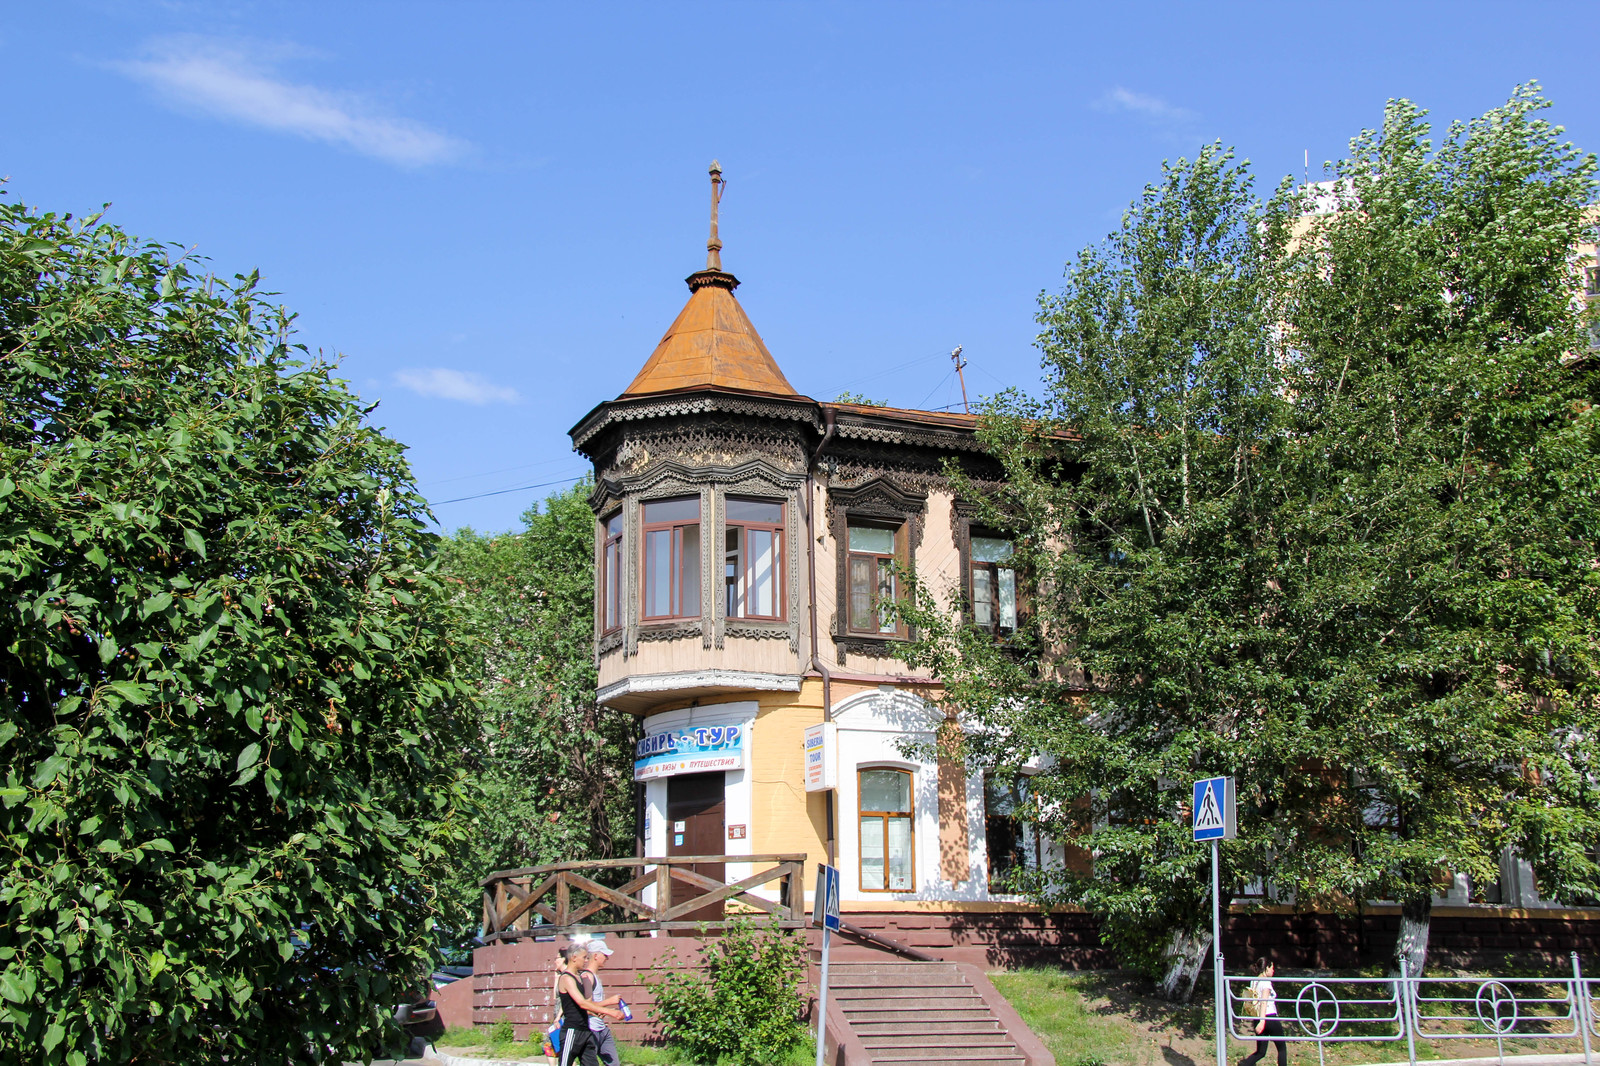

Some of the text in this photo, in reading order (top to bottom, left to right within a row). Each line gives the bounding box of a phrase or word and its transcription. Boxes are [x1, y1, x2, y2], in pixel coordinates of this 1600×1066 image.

[637, 733, 675, 756] СИБИРЬ
[695, 726, 740, 747] ТУР
[807, 736, 824, 749] SIBERIA
[662, 763, 677, 772] ВИЗЫ
[689, 758, 735, 768] ПУТЕШЕСТВИЯ
